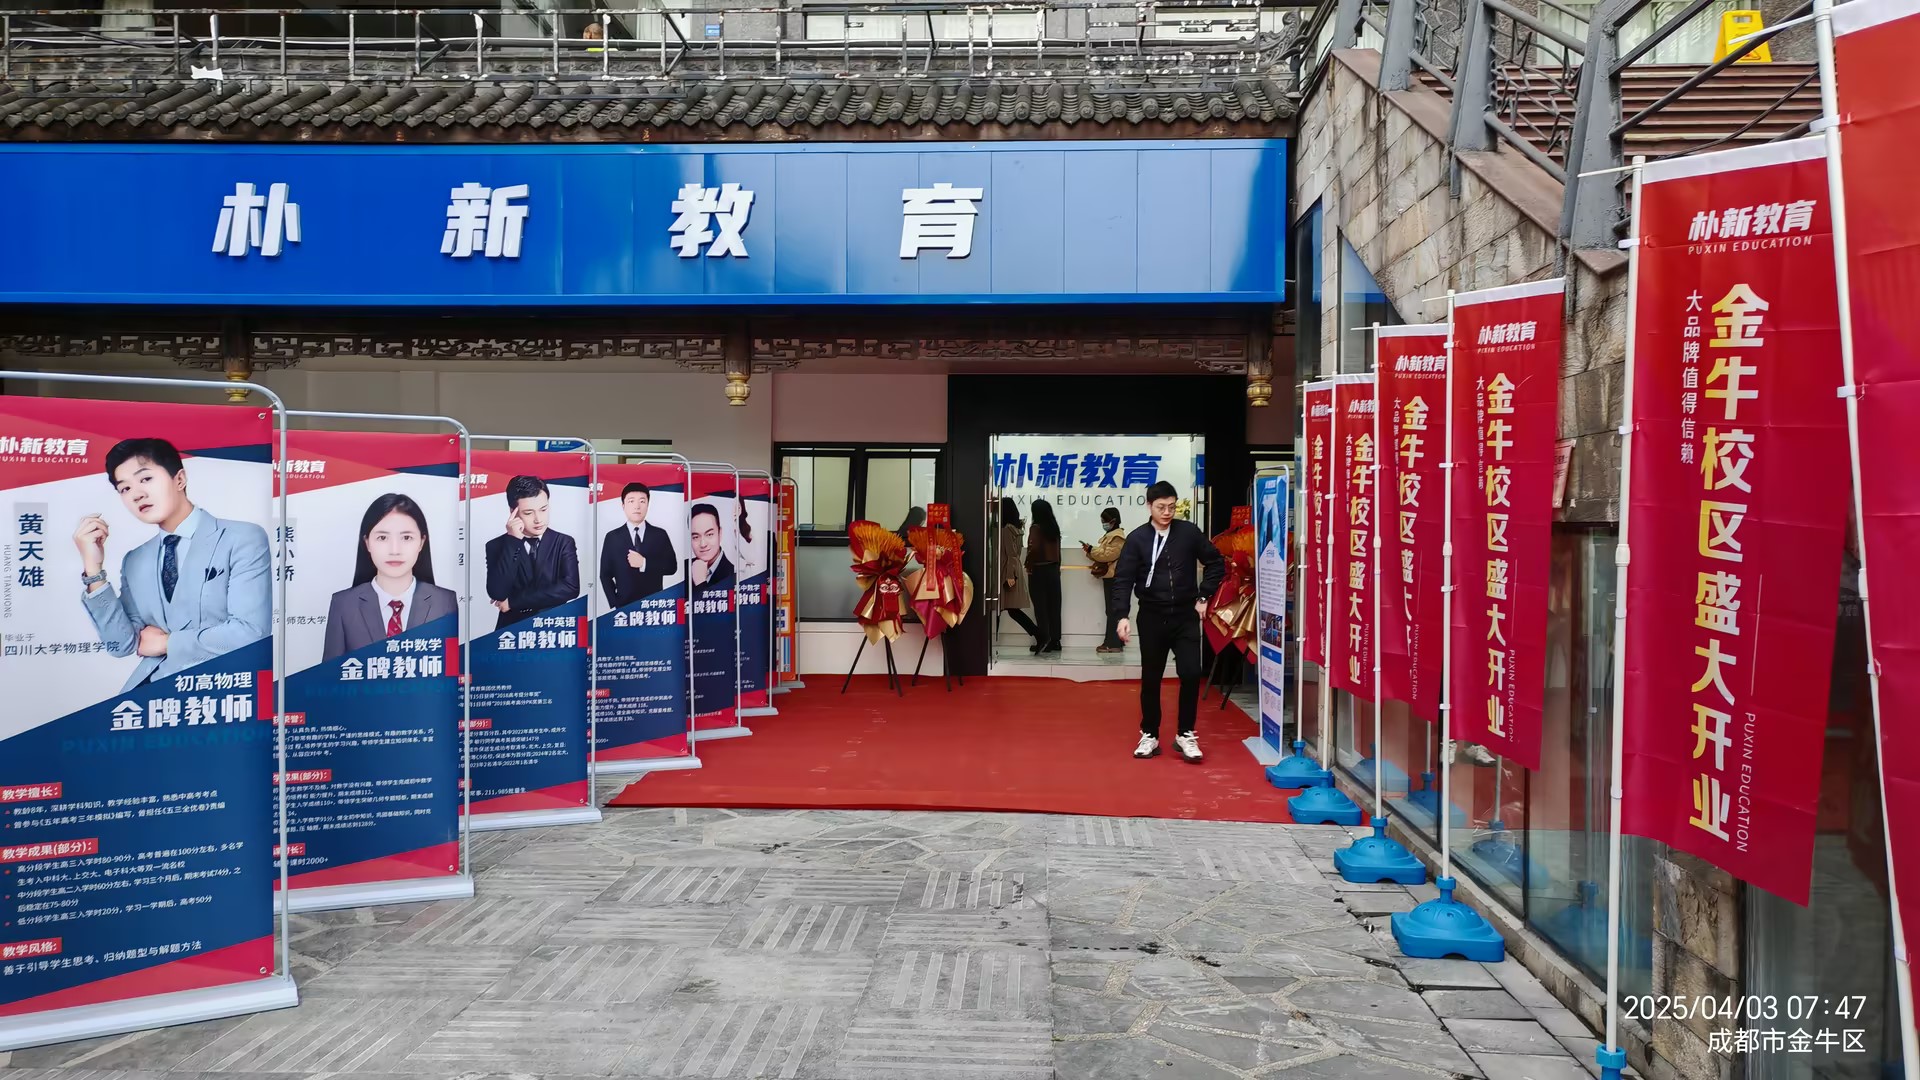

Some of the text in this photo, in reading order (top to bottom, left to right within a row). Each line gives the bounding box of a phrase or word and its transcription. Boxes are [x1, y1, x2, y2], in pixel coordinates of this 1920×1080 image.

[211, 182, 985, 259] 朴新教育
[1687, 199, 1817, 242] 朴新教育
[1688, 235, 1814, 255] PUXIN EDUCATION
[1477, 320, 1537, 345] 朴新教育
[1394, 355, 1448, 372] 朴新教育
[1680, 289, 1704, 465] 大品牌值得信赖
[0, 436, 90, 457] 朴新教育
[0, 456, 89, 464] UXIN EDUCATION
[994, 452, 1162, 488] 朴新教育
[1056, 494, 1148, 506] EDUCATIO
[18, 513, 45, 588] 黄天雄
[1348, 433, 1374, 685] 金牛校区盛大开业
[1485, 372, 1516, 739] 金牛校区盛大开业
[1688, 283, 1770, 843] 金牛校区盛大开业
[3, 544, 12, 619] HUANG TIANXIONG
[640, 598, 676, 610] 高中数学
[702, 590, 728, 599] 高中英语
[532, 616, 576, 628] 高中英语
[613, 610, 676, 628] 金牌教师
[4, 632, 36, 642] 毕业于
[386, 638, 442, 653] 高中数学
[497, 630, 577, 650] 金牌教师
[4, 641, 121, 657] 四川大学物理学院
[340, 655, 443, 681] 金牌教师
[174, 671, 253, 692] 初高物理
[1507, 649, 1516, 743] PUXIN EDUCATION
[110, 692, 254, 732] 金牌教师
[2, 785, 60, 800] 教学擅长：
[1736, 711, 1756, 853] PUXIN EDUCATION
